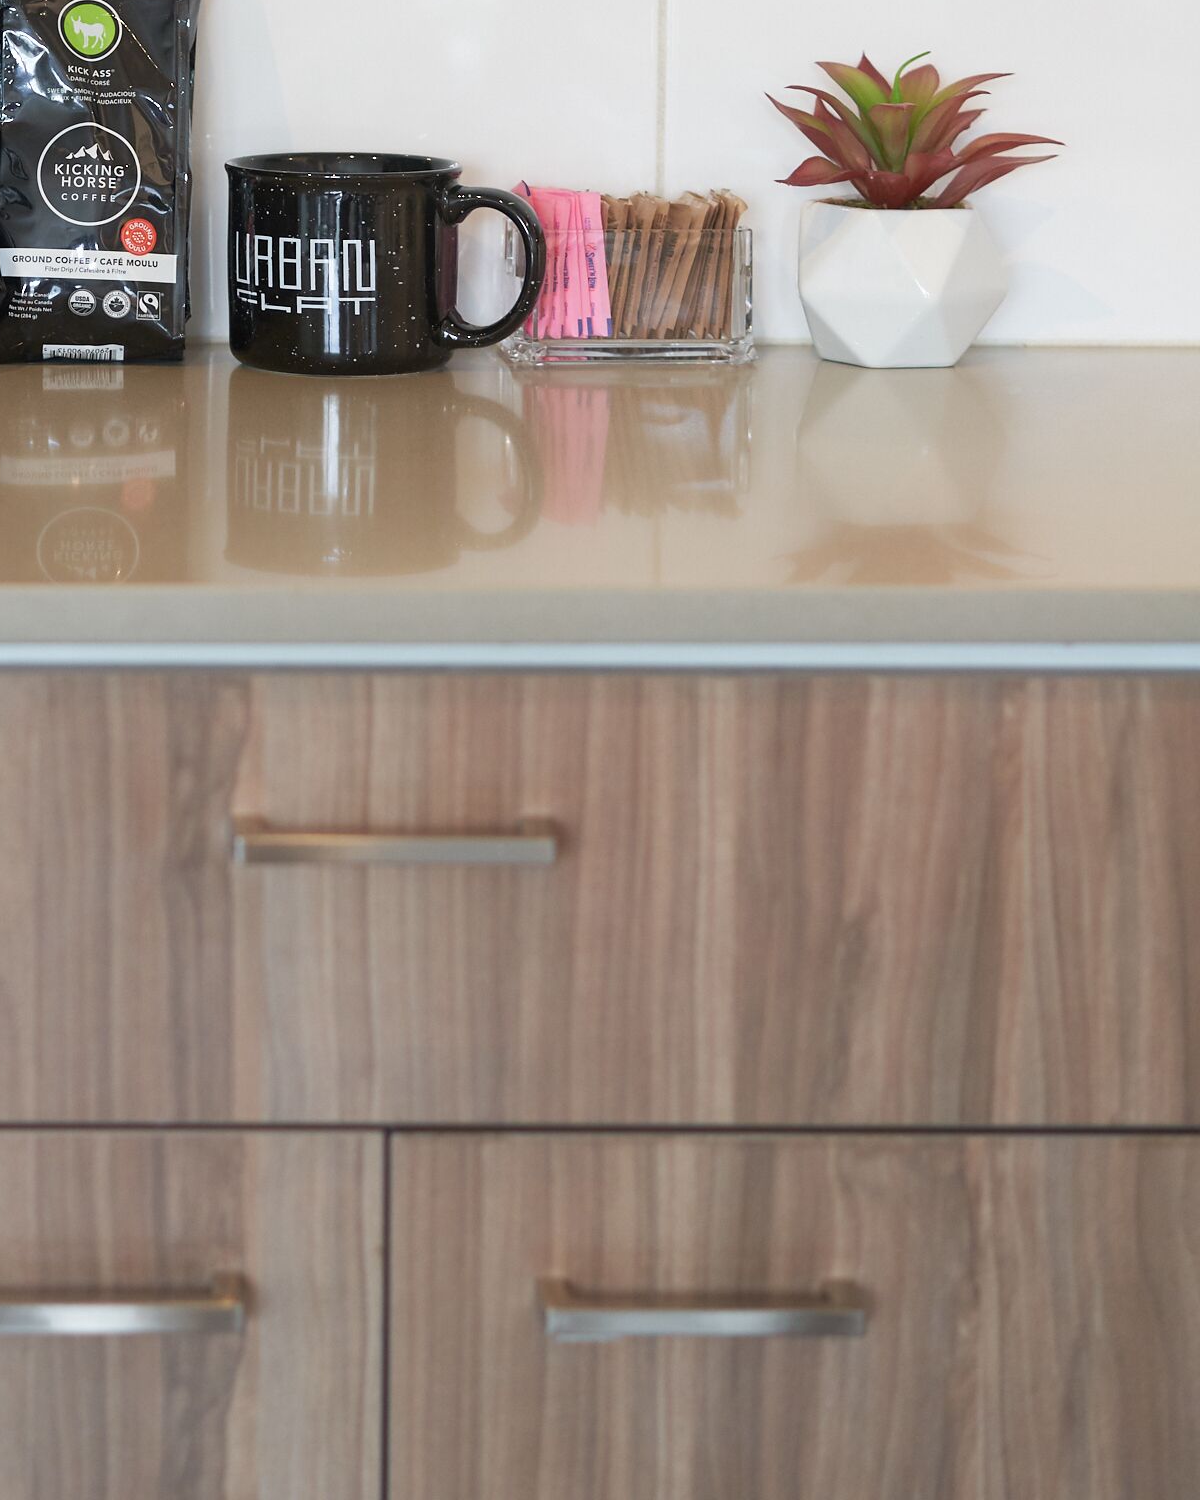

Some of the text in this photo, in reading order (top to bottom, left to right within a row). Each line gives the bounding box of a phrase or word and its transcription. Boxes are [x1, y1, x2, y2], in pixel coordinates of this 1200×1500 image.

[68, 64, 112, 78] KICK ASS
[54, 164, 124, 177] KICKING
[61, 176, 116, 188] HORSE
[61, 193, 116, 202] COFFEE
[129, 222, 153, 240] GROUND
[125, 238, 146, 252] MOULU
[100, 258, 123, 266] CAFÉ
[236, 230, 376, 292] URBAN
